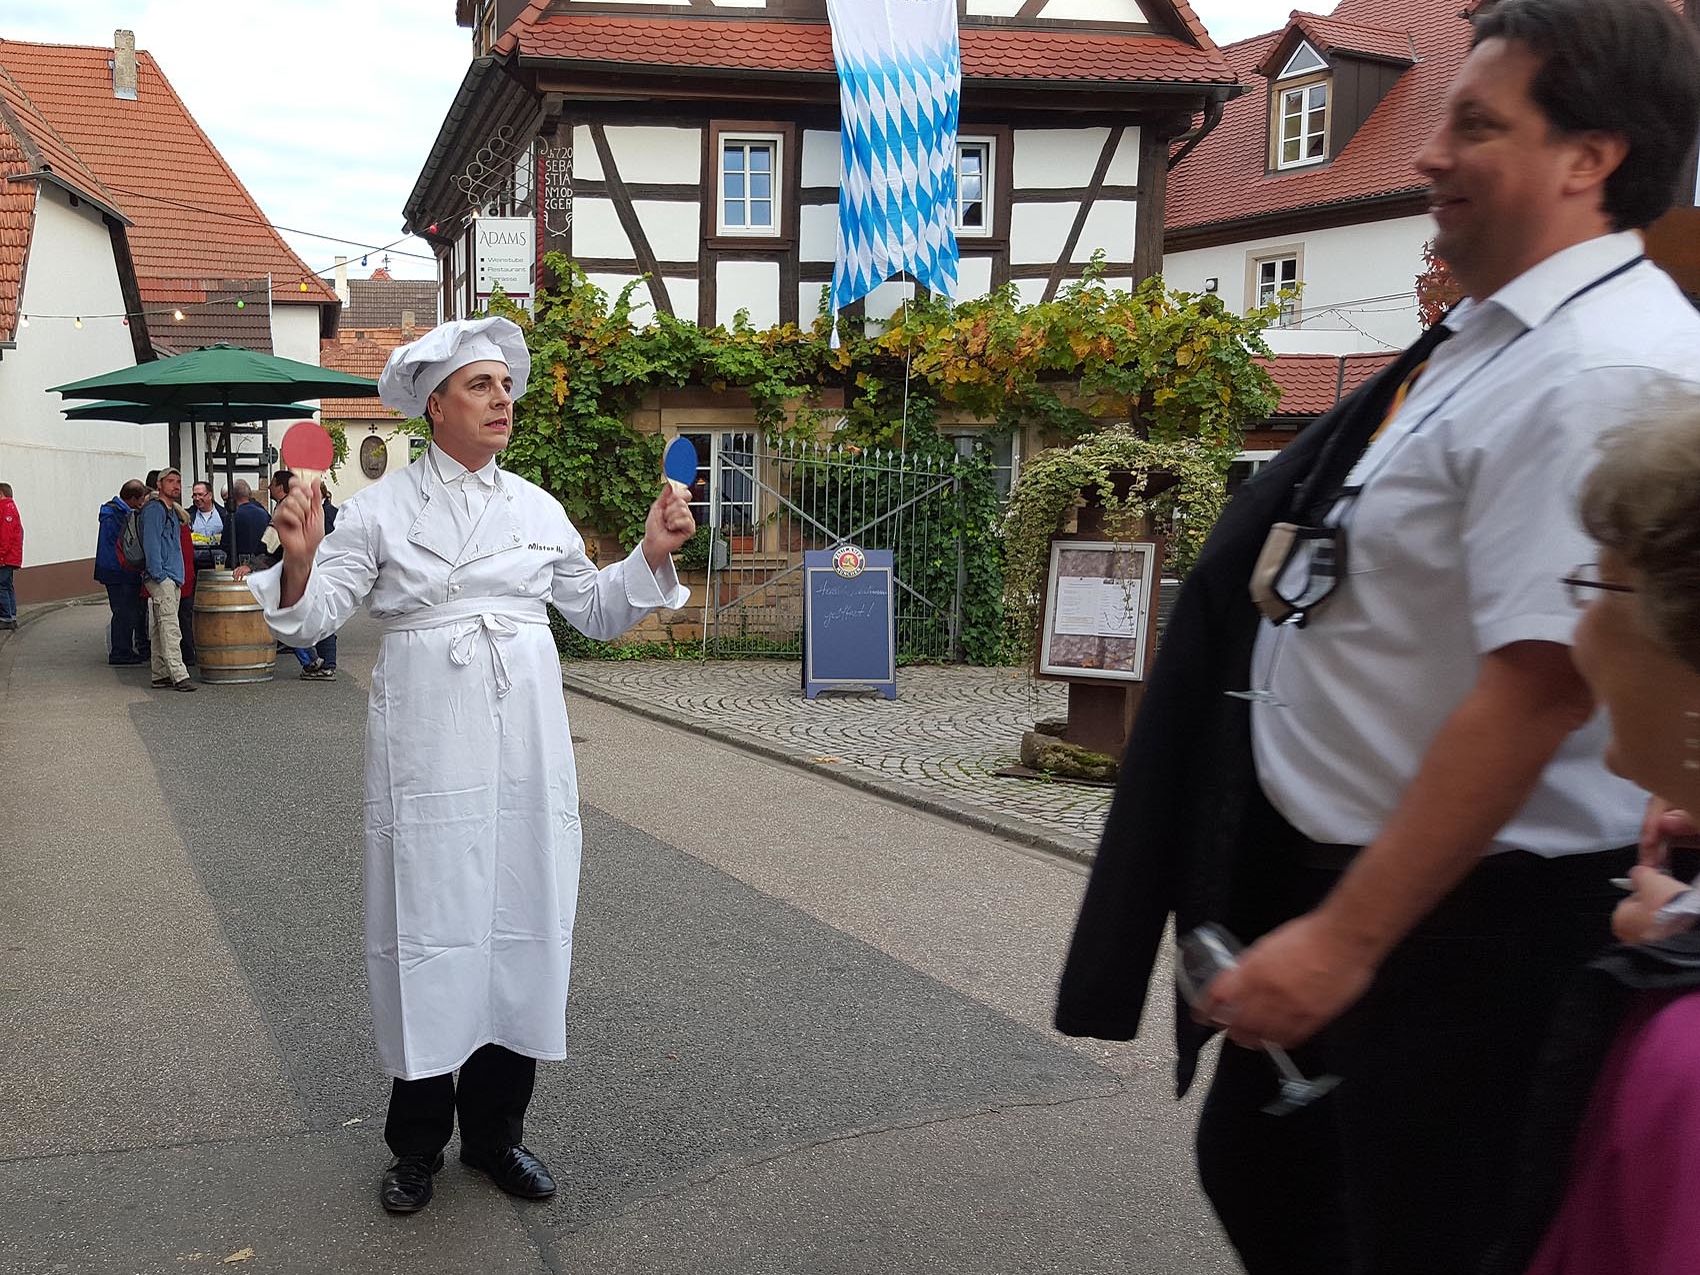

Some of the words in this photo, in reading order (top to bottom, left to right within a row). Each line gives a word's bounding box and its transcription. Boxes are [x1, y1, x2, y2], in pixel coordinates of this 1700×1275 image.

[545, 160, 573, 172] SEBA
[544, 172, 571, 185] STIA
[480, 230, 527, 248] ADAMS
[527, 542, 554, 551] Mister
